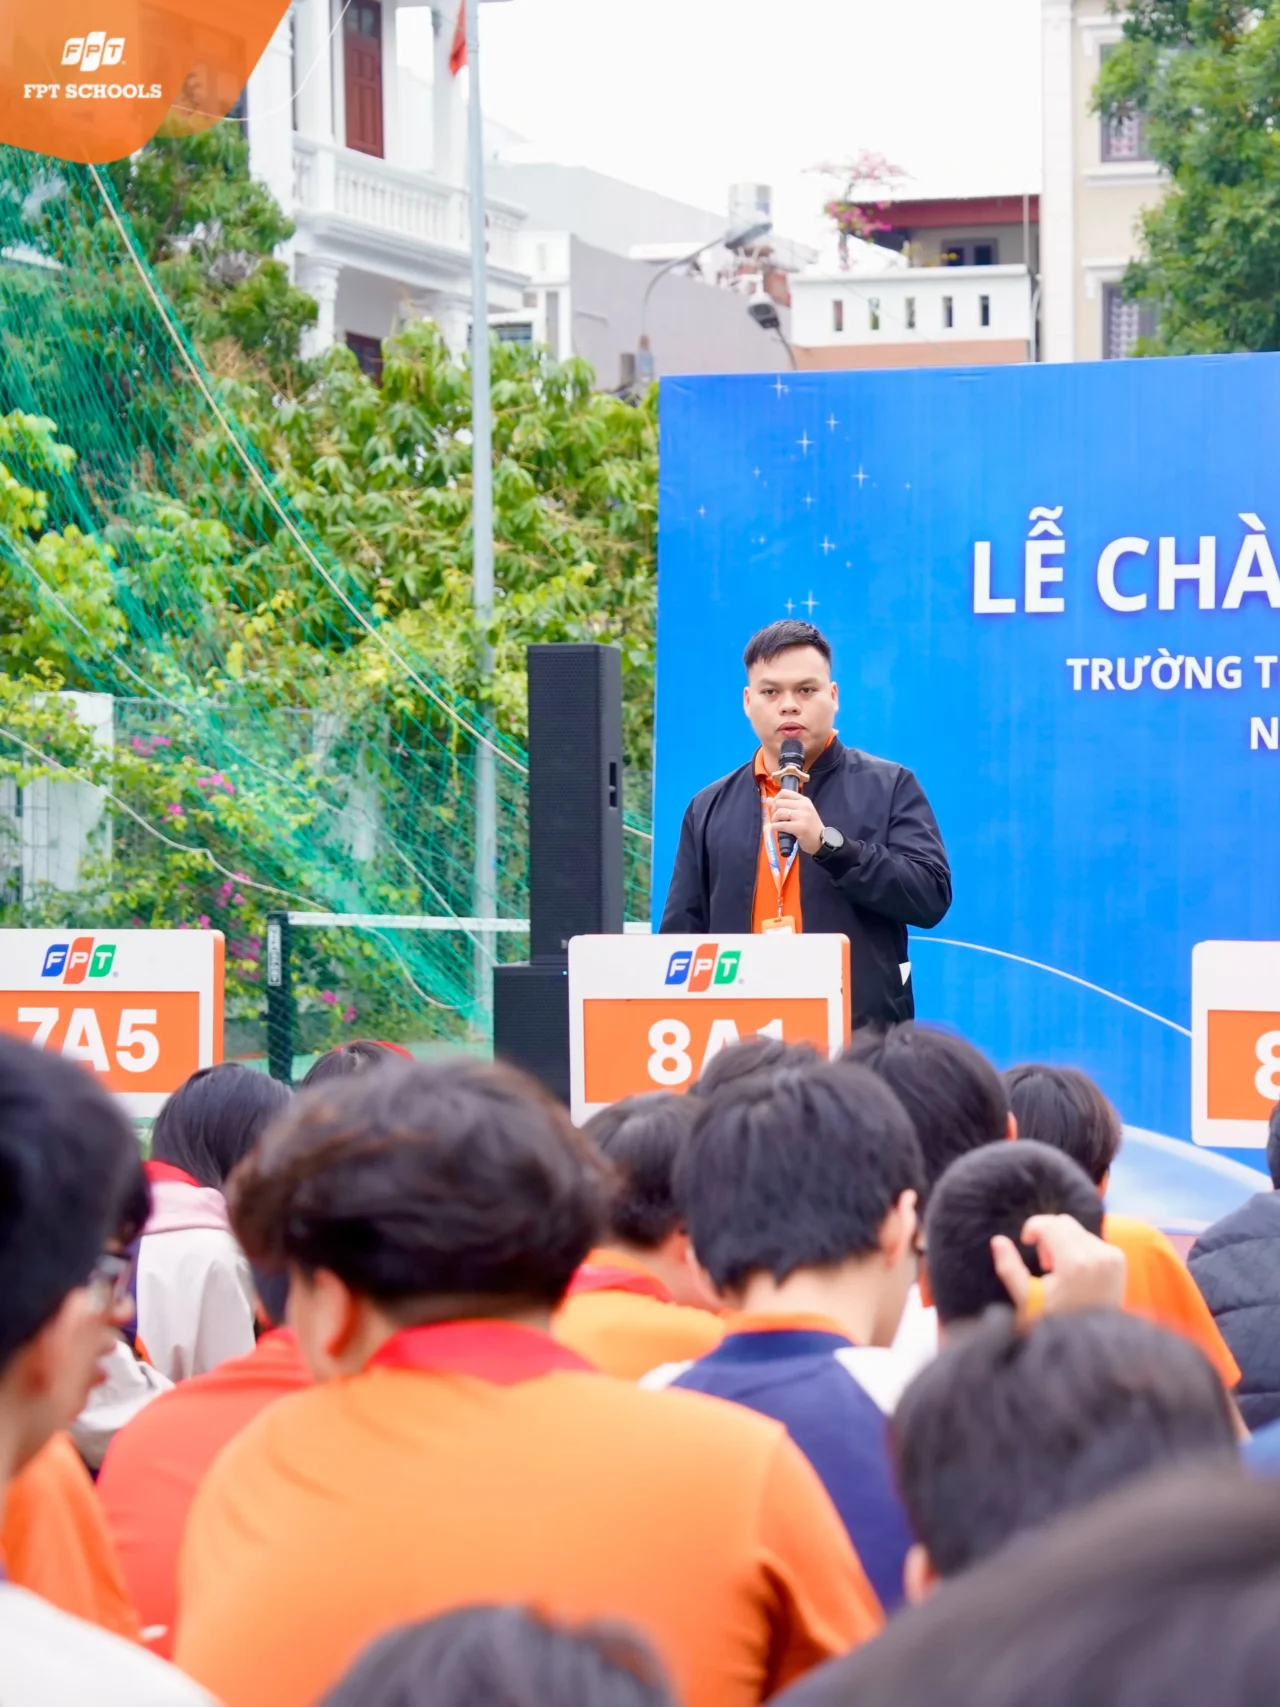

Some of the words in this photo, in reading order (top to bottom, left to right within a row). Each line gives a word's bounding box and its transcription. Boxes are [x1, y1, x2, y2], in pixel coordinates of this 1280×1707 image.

[974, 506, 1066, 614] LỄ
[1066, 648, 1242, 691] TRƯỜNG
[41, 936, 117, 985] FPT
[664, 943, 742, 993] FPT
[17, 1007, 160, 1073] 7A5
